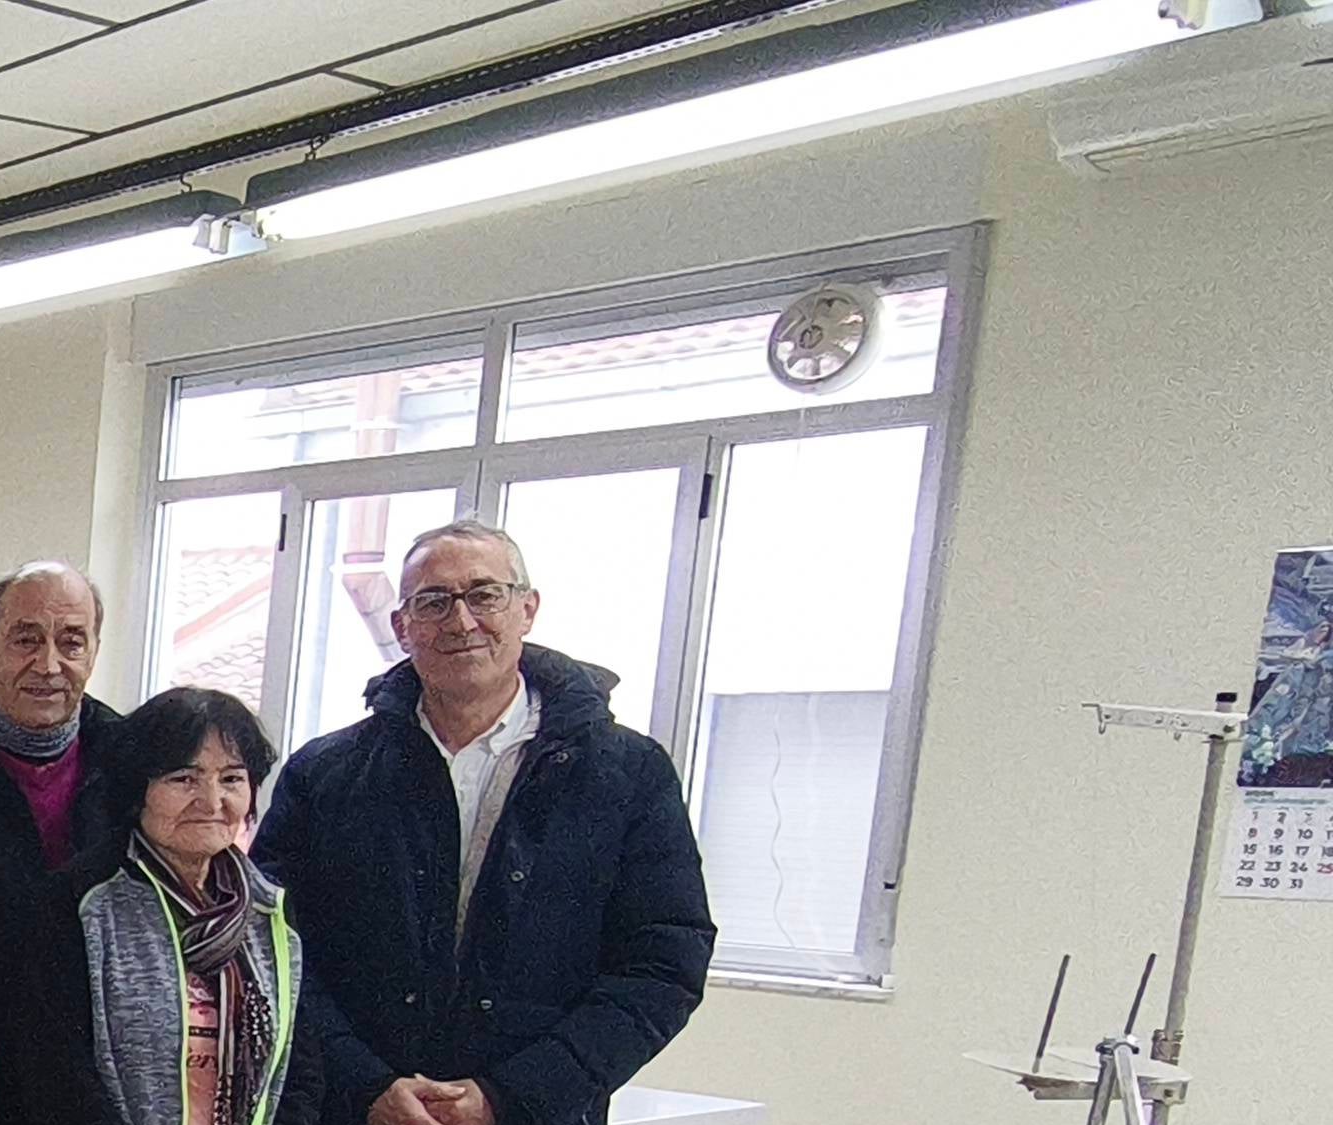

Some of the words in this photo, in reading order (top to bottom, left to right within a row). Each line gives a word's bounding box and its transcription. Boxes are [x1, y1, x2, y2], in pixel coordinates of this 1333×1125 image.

[1248, 828, 1258, 839] 8
[1273, 828, 1284, 839] 9
[1297, 828, 1313, 840] 10
[1243, 843, 1257, 855] 15
[1268, 844, 1284, 856] 16
[1295, 845, 1310, 857] 17
[1239, 860, 1255, 871] 22
[1264, 861, 1282, 872] 23
[1289, 862, 1308, 873] 24
[1236, 876, 1253, 887] 29
[1259, 877, 1280, 889] 30
[1289, 878, 1303, 889] 31
